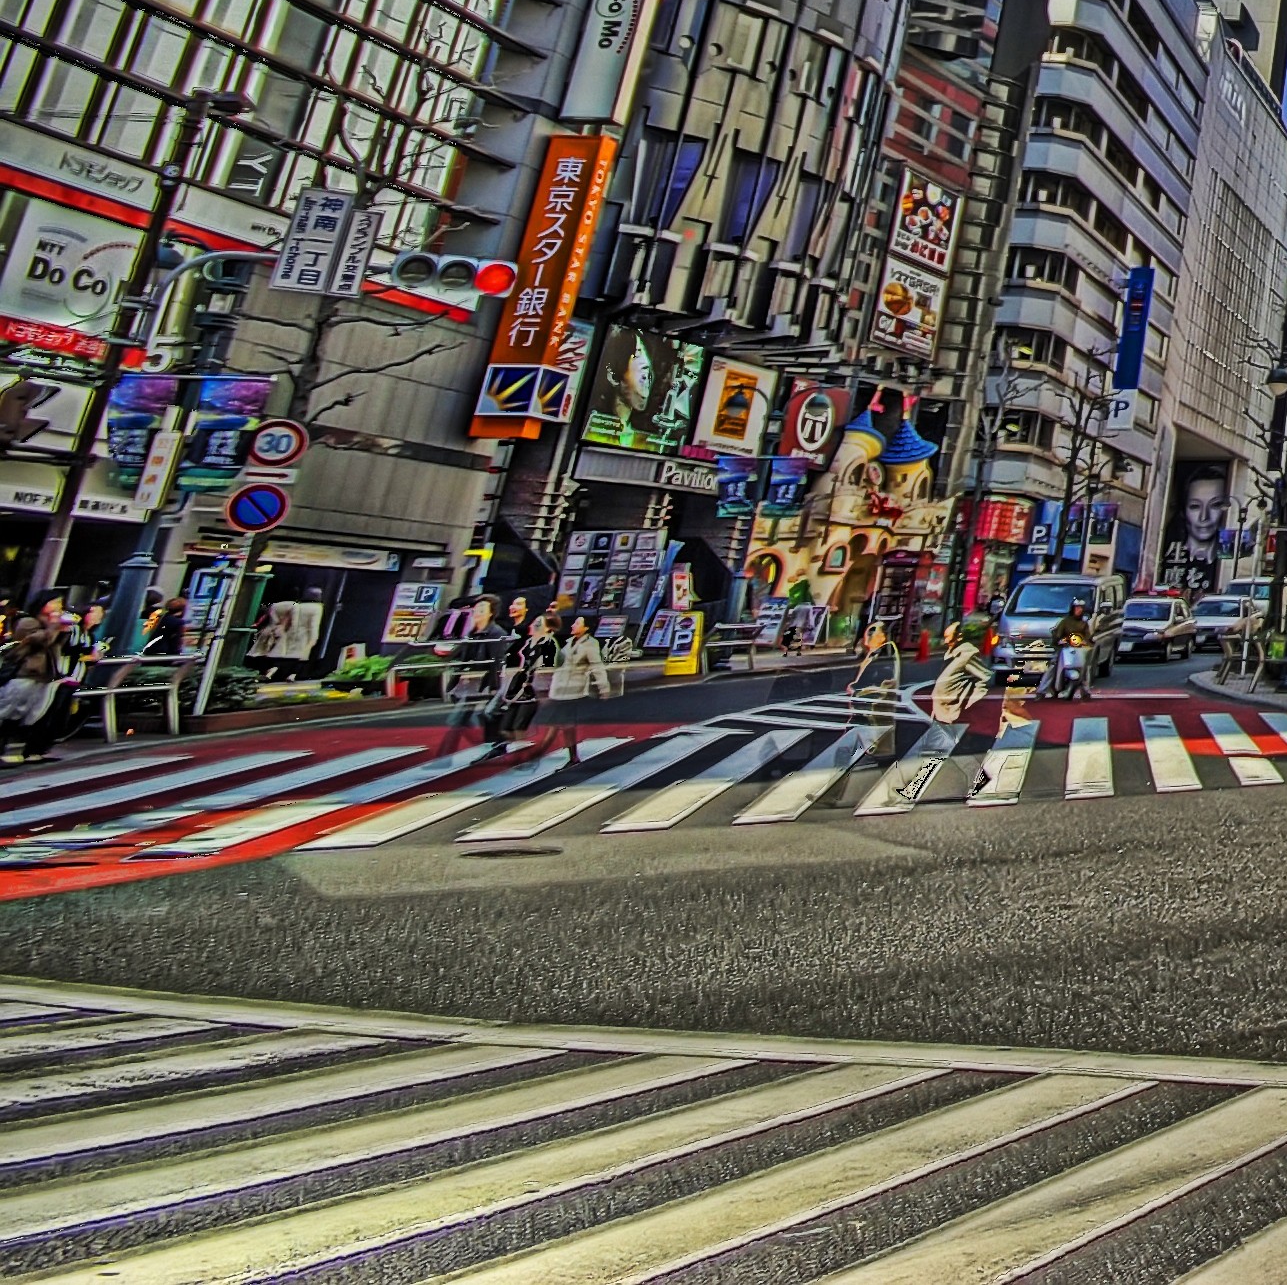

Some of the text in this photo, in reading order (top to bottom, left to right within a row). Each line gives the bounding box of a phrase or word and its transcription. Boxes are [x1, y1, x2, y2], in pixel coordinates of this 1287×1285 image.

[36, 238, 67, 257] NTT
[297, 196, 346, 286] 神南一丁目
[508, 157, 587, 347] 東京スター銀行
[549, 159, 609, 347] TOKYO STAR BANK
[1113, 400, 1130, 418] P
[257, 432, 295, 454] 30
[660, 461, 718, 492] Pavilio
[1032, 526, 1048, 542] P
[419, 586, 432, 600] P
